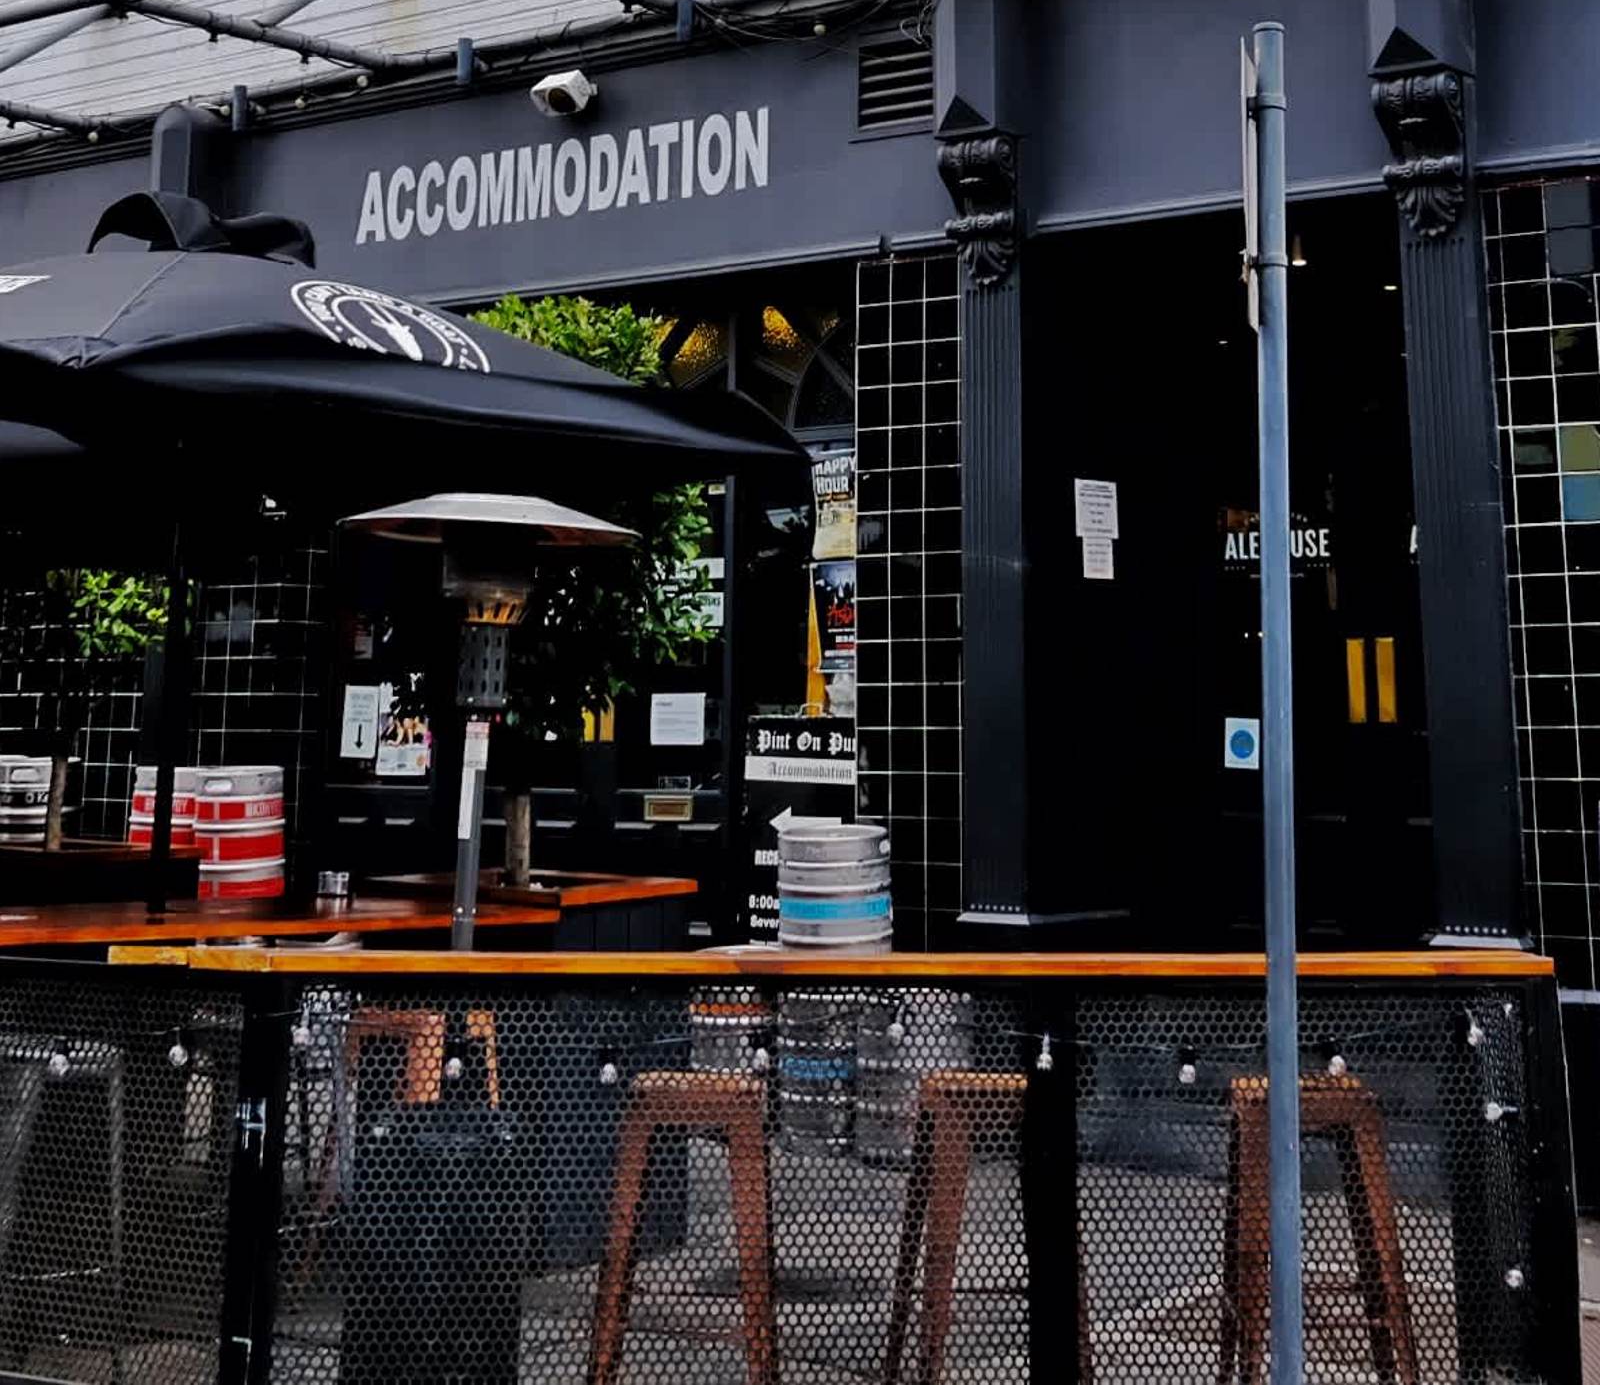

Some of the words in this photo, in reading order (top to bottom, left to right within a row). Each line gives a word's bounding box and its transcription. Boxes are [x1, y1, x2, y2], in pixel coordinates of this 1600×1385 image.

[355, 106, 770, 245] ACCOMMODATION
[814, 456, 858, 476] HAPPY
[816, 476, 849, 495] HOUR
[1224, 528, 1331, 561] ALEUSE
[756, 728, 792, 754] Pint
[796, 731, 822, 752] On
[766, 761, 853, 781] Accommodation
